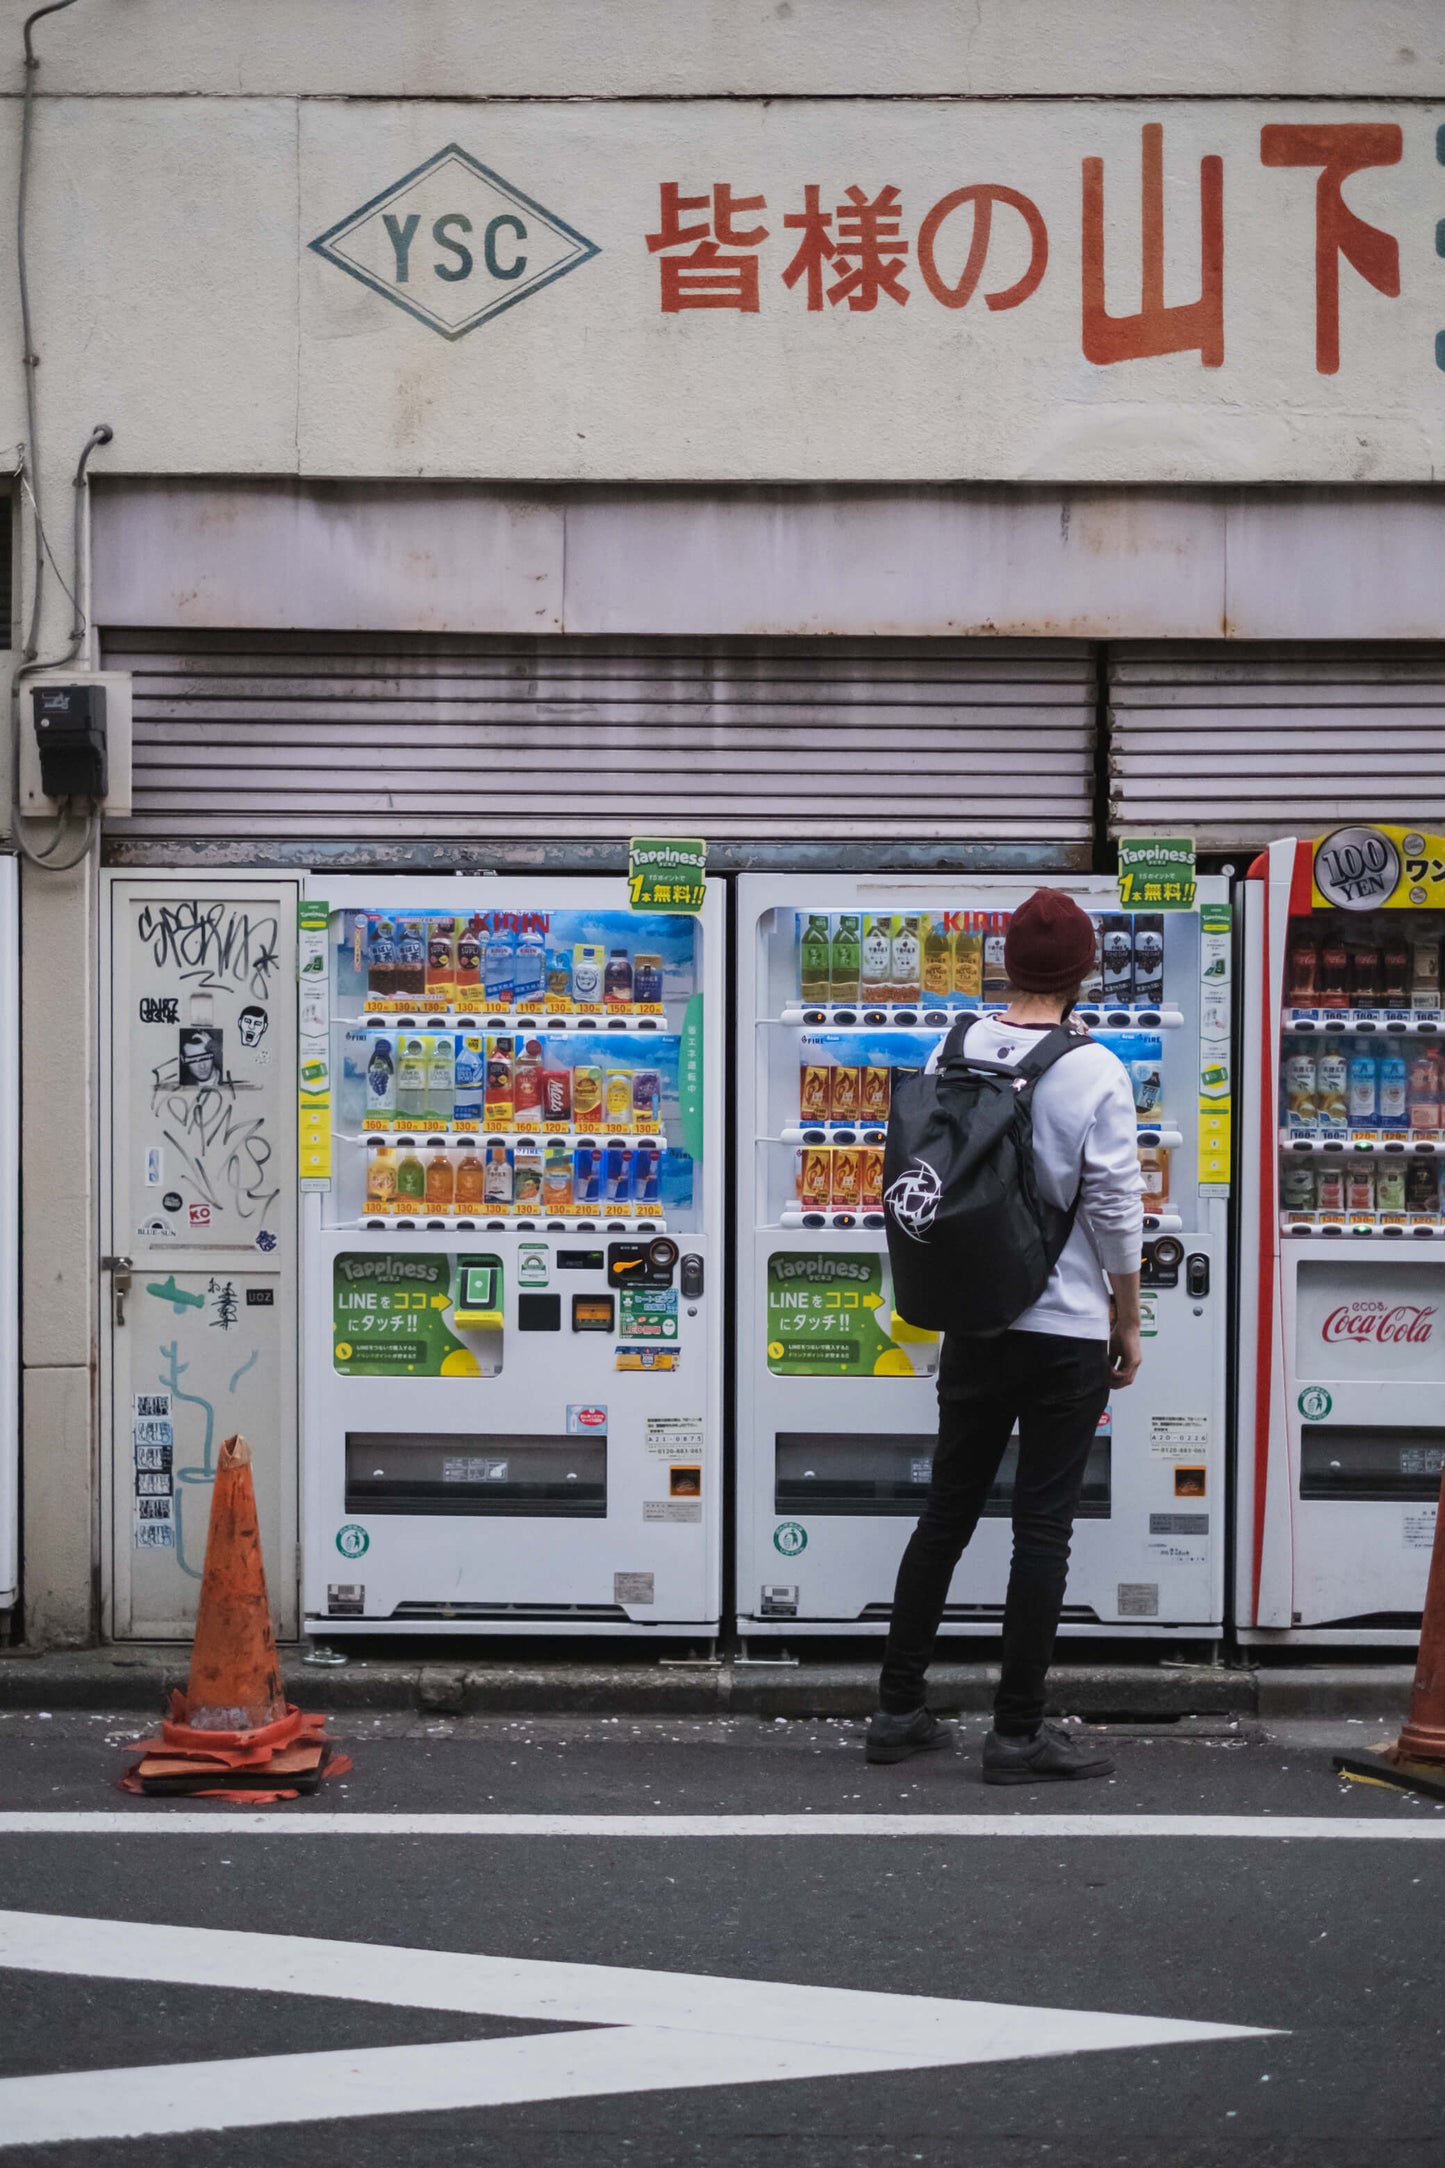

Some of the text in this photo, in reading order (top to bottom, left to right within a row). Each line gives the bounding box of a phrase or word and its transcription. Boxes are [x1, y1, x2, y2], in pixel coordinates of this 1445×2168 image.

[382, 213, 528, 283] YSC
[645, 122, 1445, 376] 皆様の山下
[629, 846, 707, 868] Tappiness
[1118, 844, 1197, 865] Tappiness
[1322, 838, 1389, 887] 100
[1338, 873, 1386, 903] YEN
[474, 912, 550, 934] KIRIN
[549, 1079, 564, 1112] Mets
[189, 1207, 211, 1221] KO
[338, 1255, 440, 1282] Tappiness
[770, 1254, 872, 1282] Tappiness
